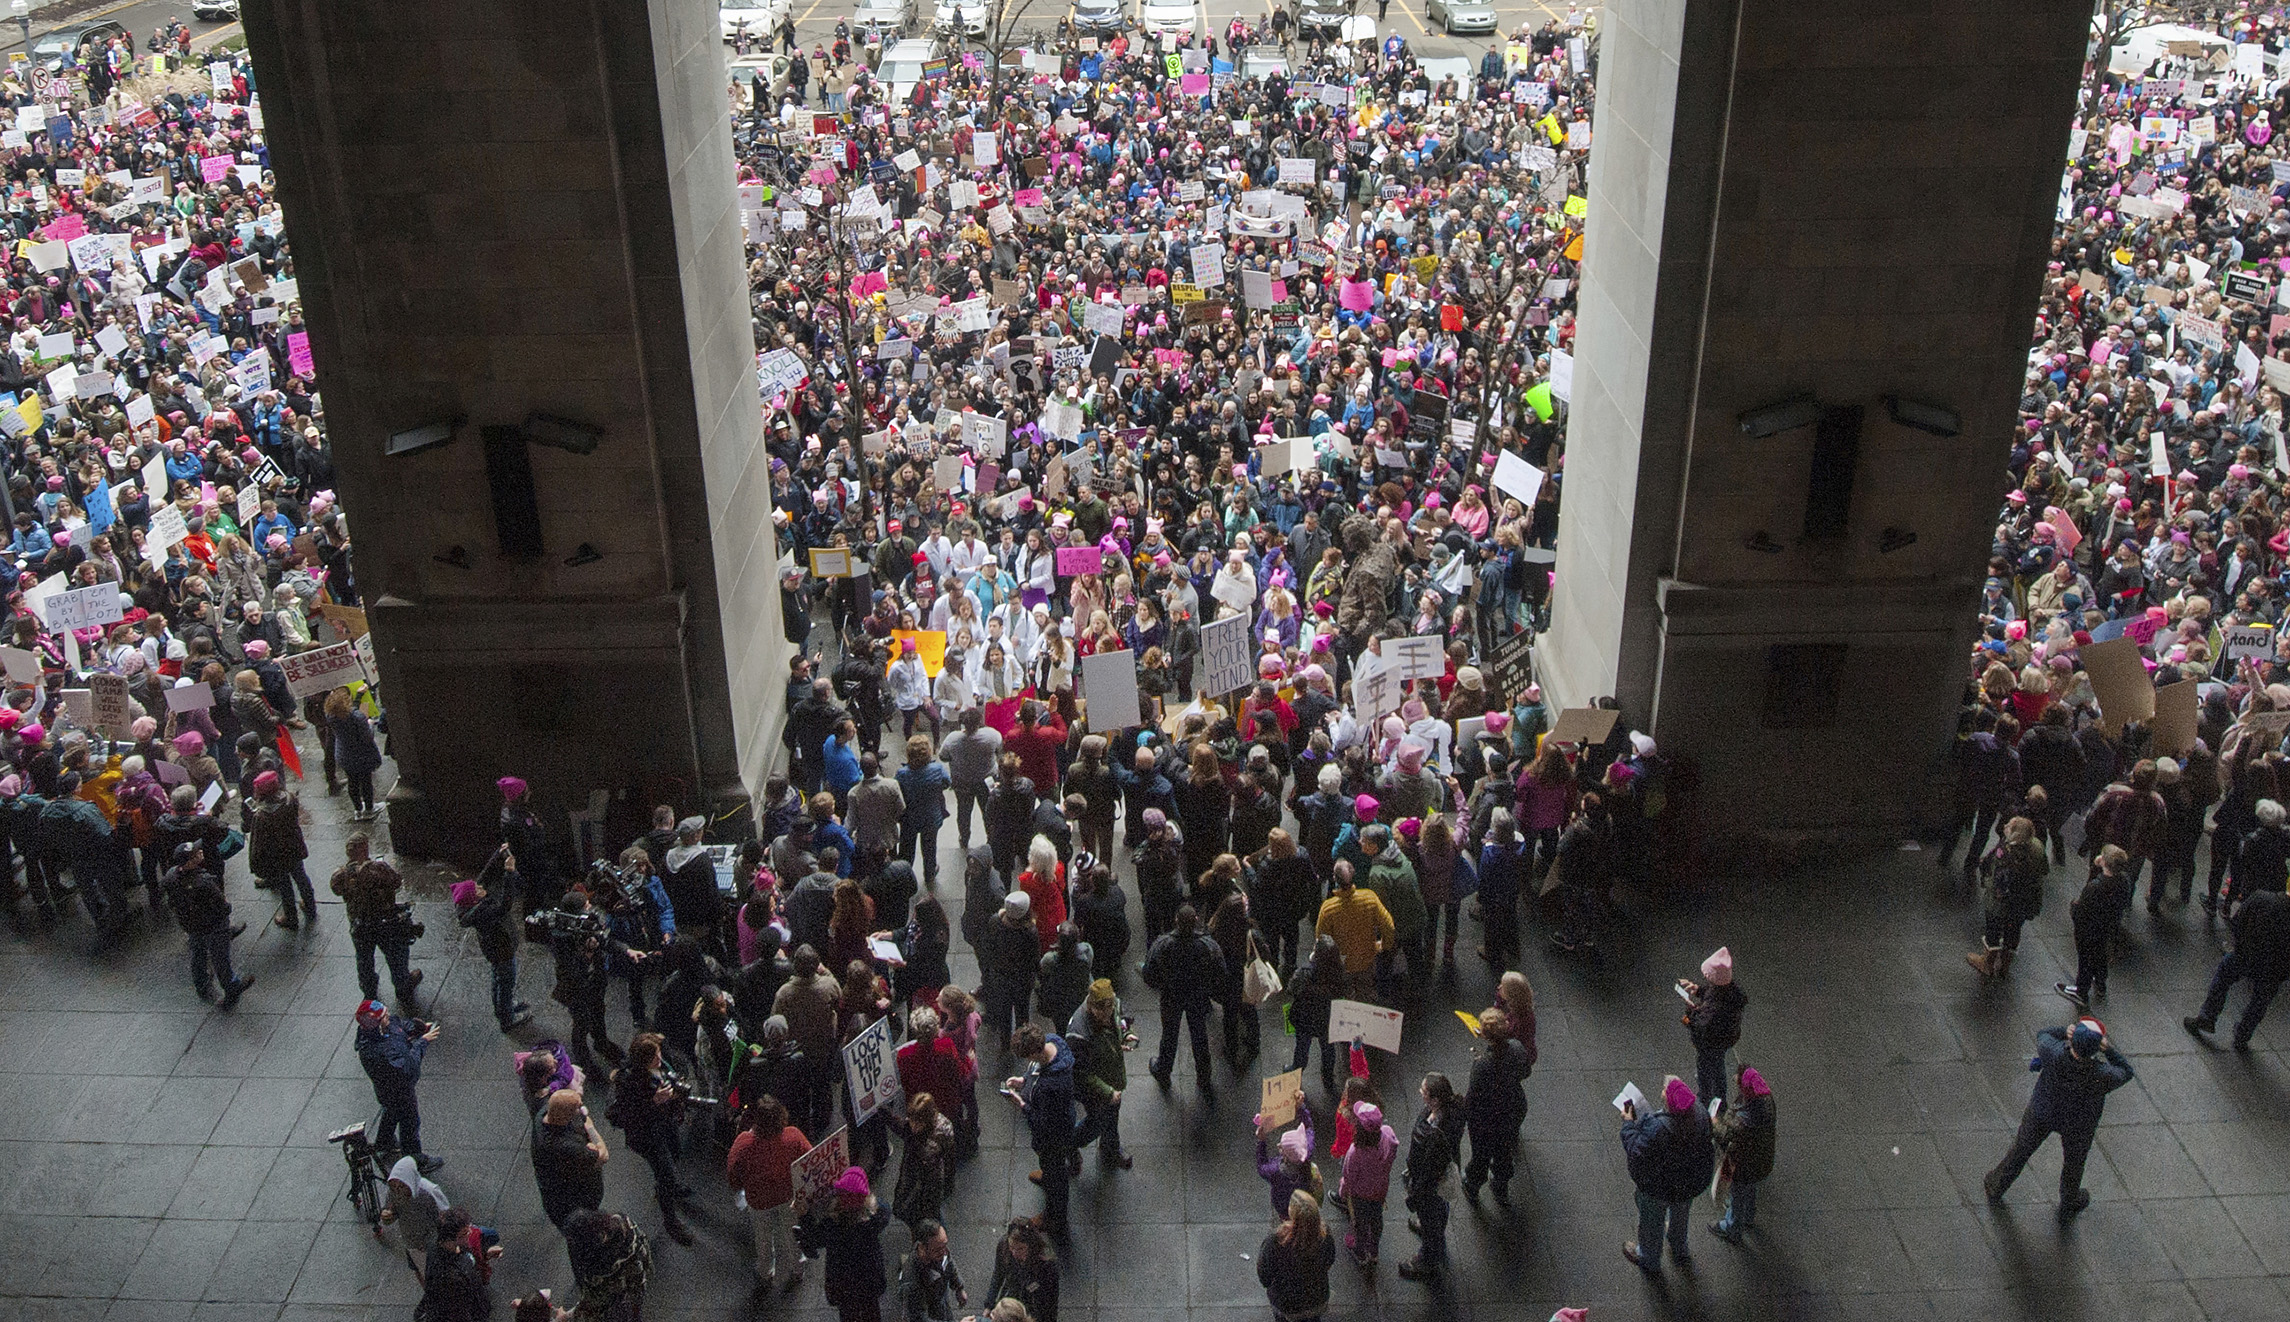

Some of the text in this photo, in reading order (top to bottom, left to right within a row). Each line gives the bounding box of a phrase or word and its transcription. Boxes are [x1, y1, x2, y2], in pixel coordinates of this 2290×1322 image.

[1349, 144, 1367, 154] LOVE
[874, 169, 895, 180] Lamb
[144, 179, 163, 196] SISTER
[1383, 189, 1398, 198] LOV
[1172, 284, 1203, 293] RESPECT
[244, 363, 262, 375] VOTE
[758, 353, 799, 382] KNOLL
[785, 367, 802, 381] 44
[247, 379, 265, 392] VOICE
[906, 432, 929, 444] STILL
[910, 441, 930, 449] WITH
[909, 446, 930, 455] HER
[48, 587, 107, 608] GRAB 'EM
[61, 601, 110, 616] BY THE
[1207, 617, 1241, 645] FREE
[1208, 641, 1248, 669] YOUR
[1500, 638, 1521, 658] TURN
[281, 644, 350, 671] WE WILL NOT
[1494, 645, 1529, 673] CONGRESS
[286, 668, 305, 683] BE
[305, 654, 355, 677] SILENCED
[94, 677, 124, 687] CONOR
[1209, 665, 1250, 695] MIND
[96, 687, 122, 695] LAMB
[1504, 680, 1528, 700] VOTE!
[850, 1027, 886, 1065] LOCK
[859, 1048, 882, 1079] HIM
[863, 1070, 880, 1093] UP
[800, 1138, 841, 1172] YOUR
